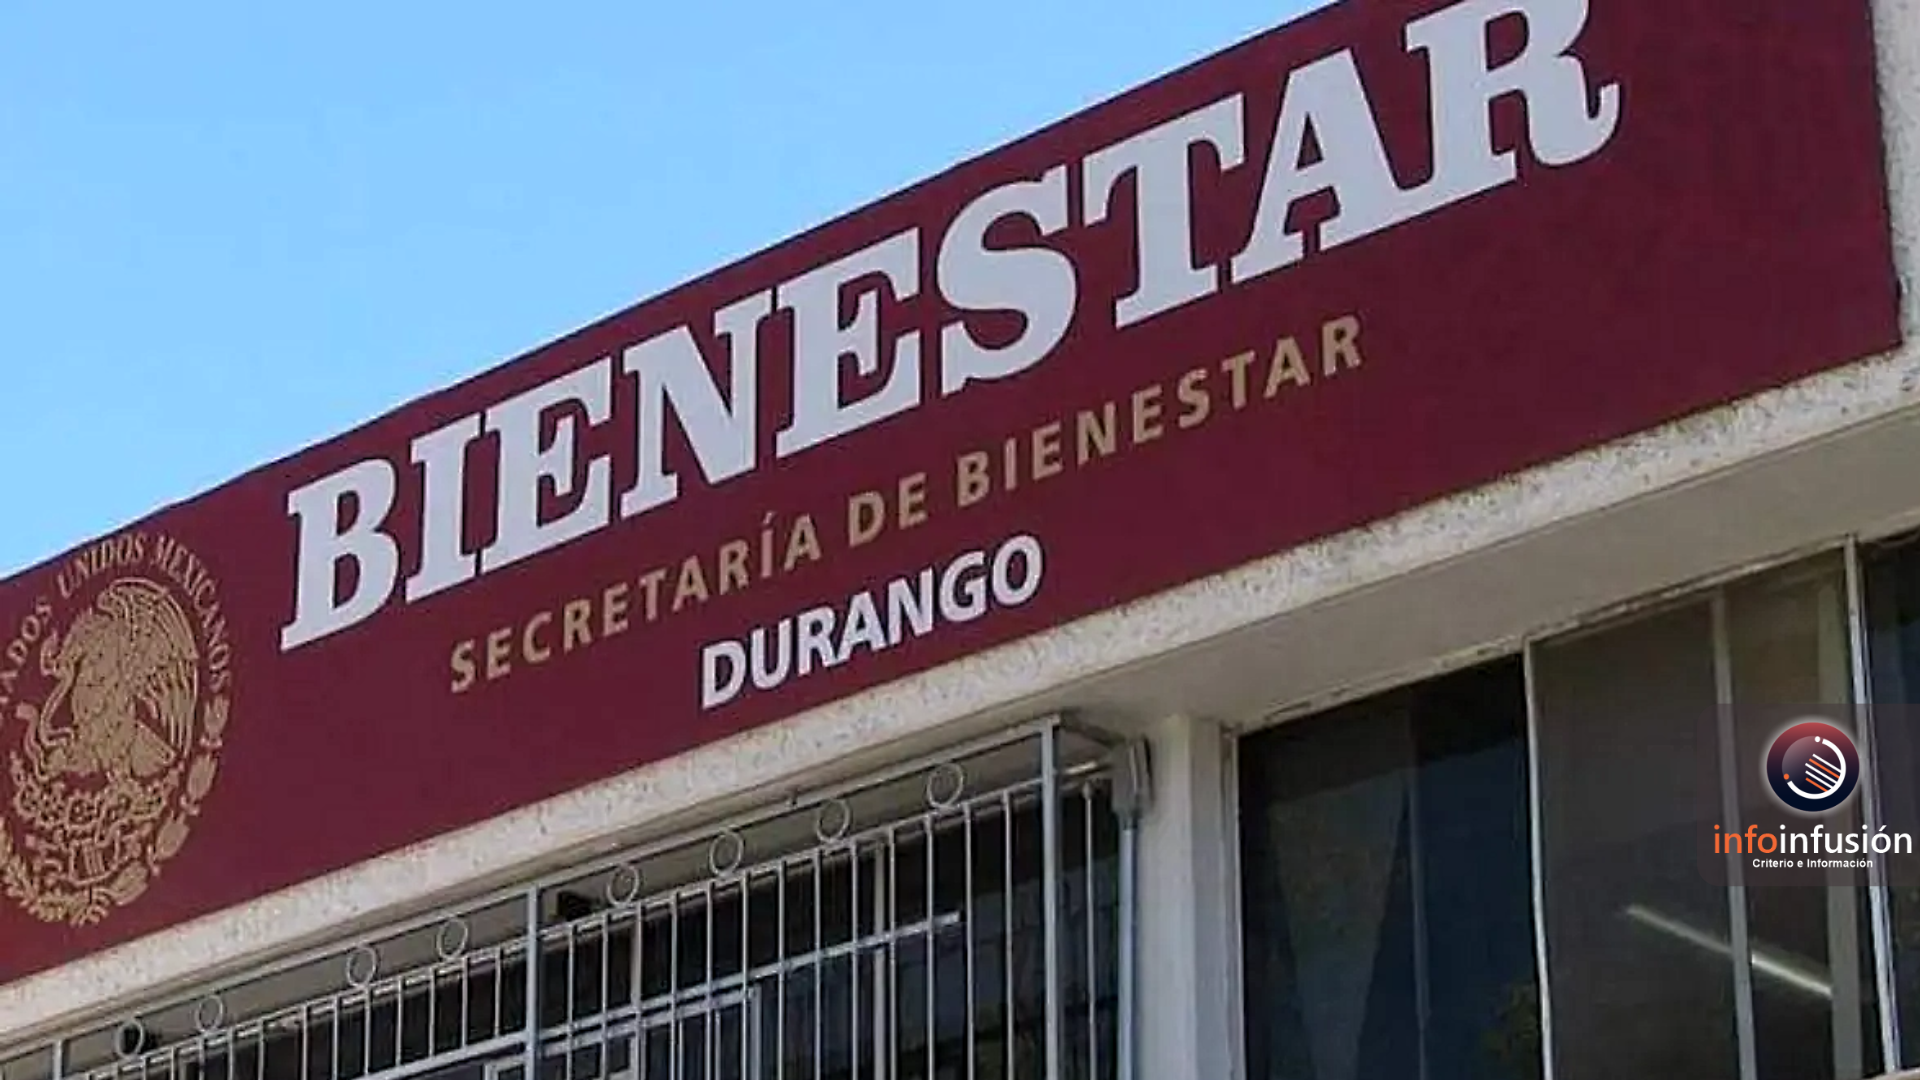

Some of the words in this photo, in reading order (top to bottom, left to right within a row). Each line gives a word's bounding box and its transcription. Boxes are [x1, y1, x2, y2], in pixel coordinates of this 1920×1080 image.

[281, 0, 1621, 651] BIENESTAR
[57, 532, 147, 599] UNIDOS
[151, 534, 232, 694] MEXICANOS
[450, 511, 821, 693] SECRETARÍA
[848, 471, 928, 547] DE
[956, 315, 1363, 507] BIENESTAR
[701, 534, 1045, 710] DURANGO
